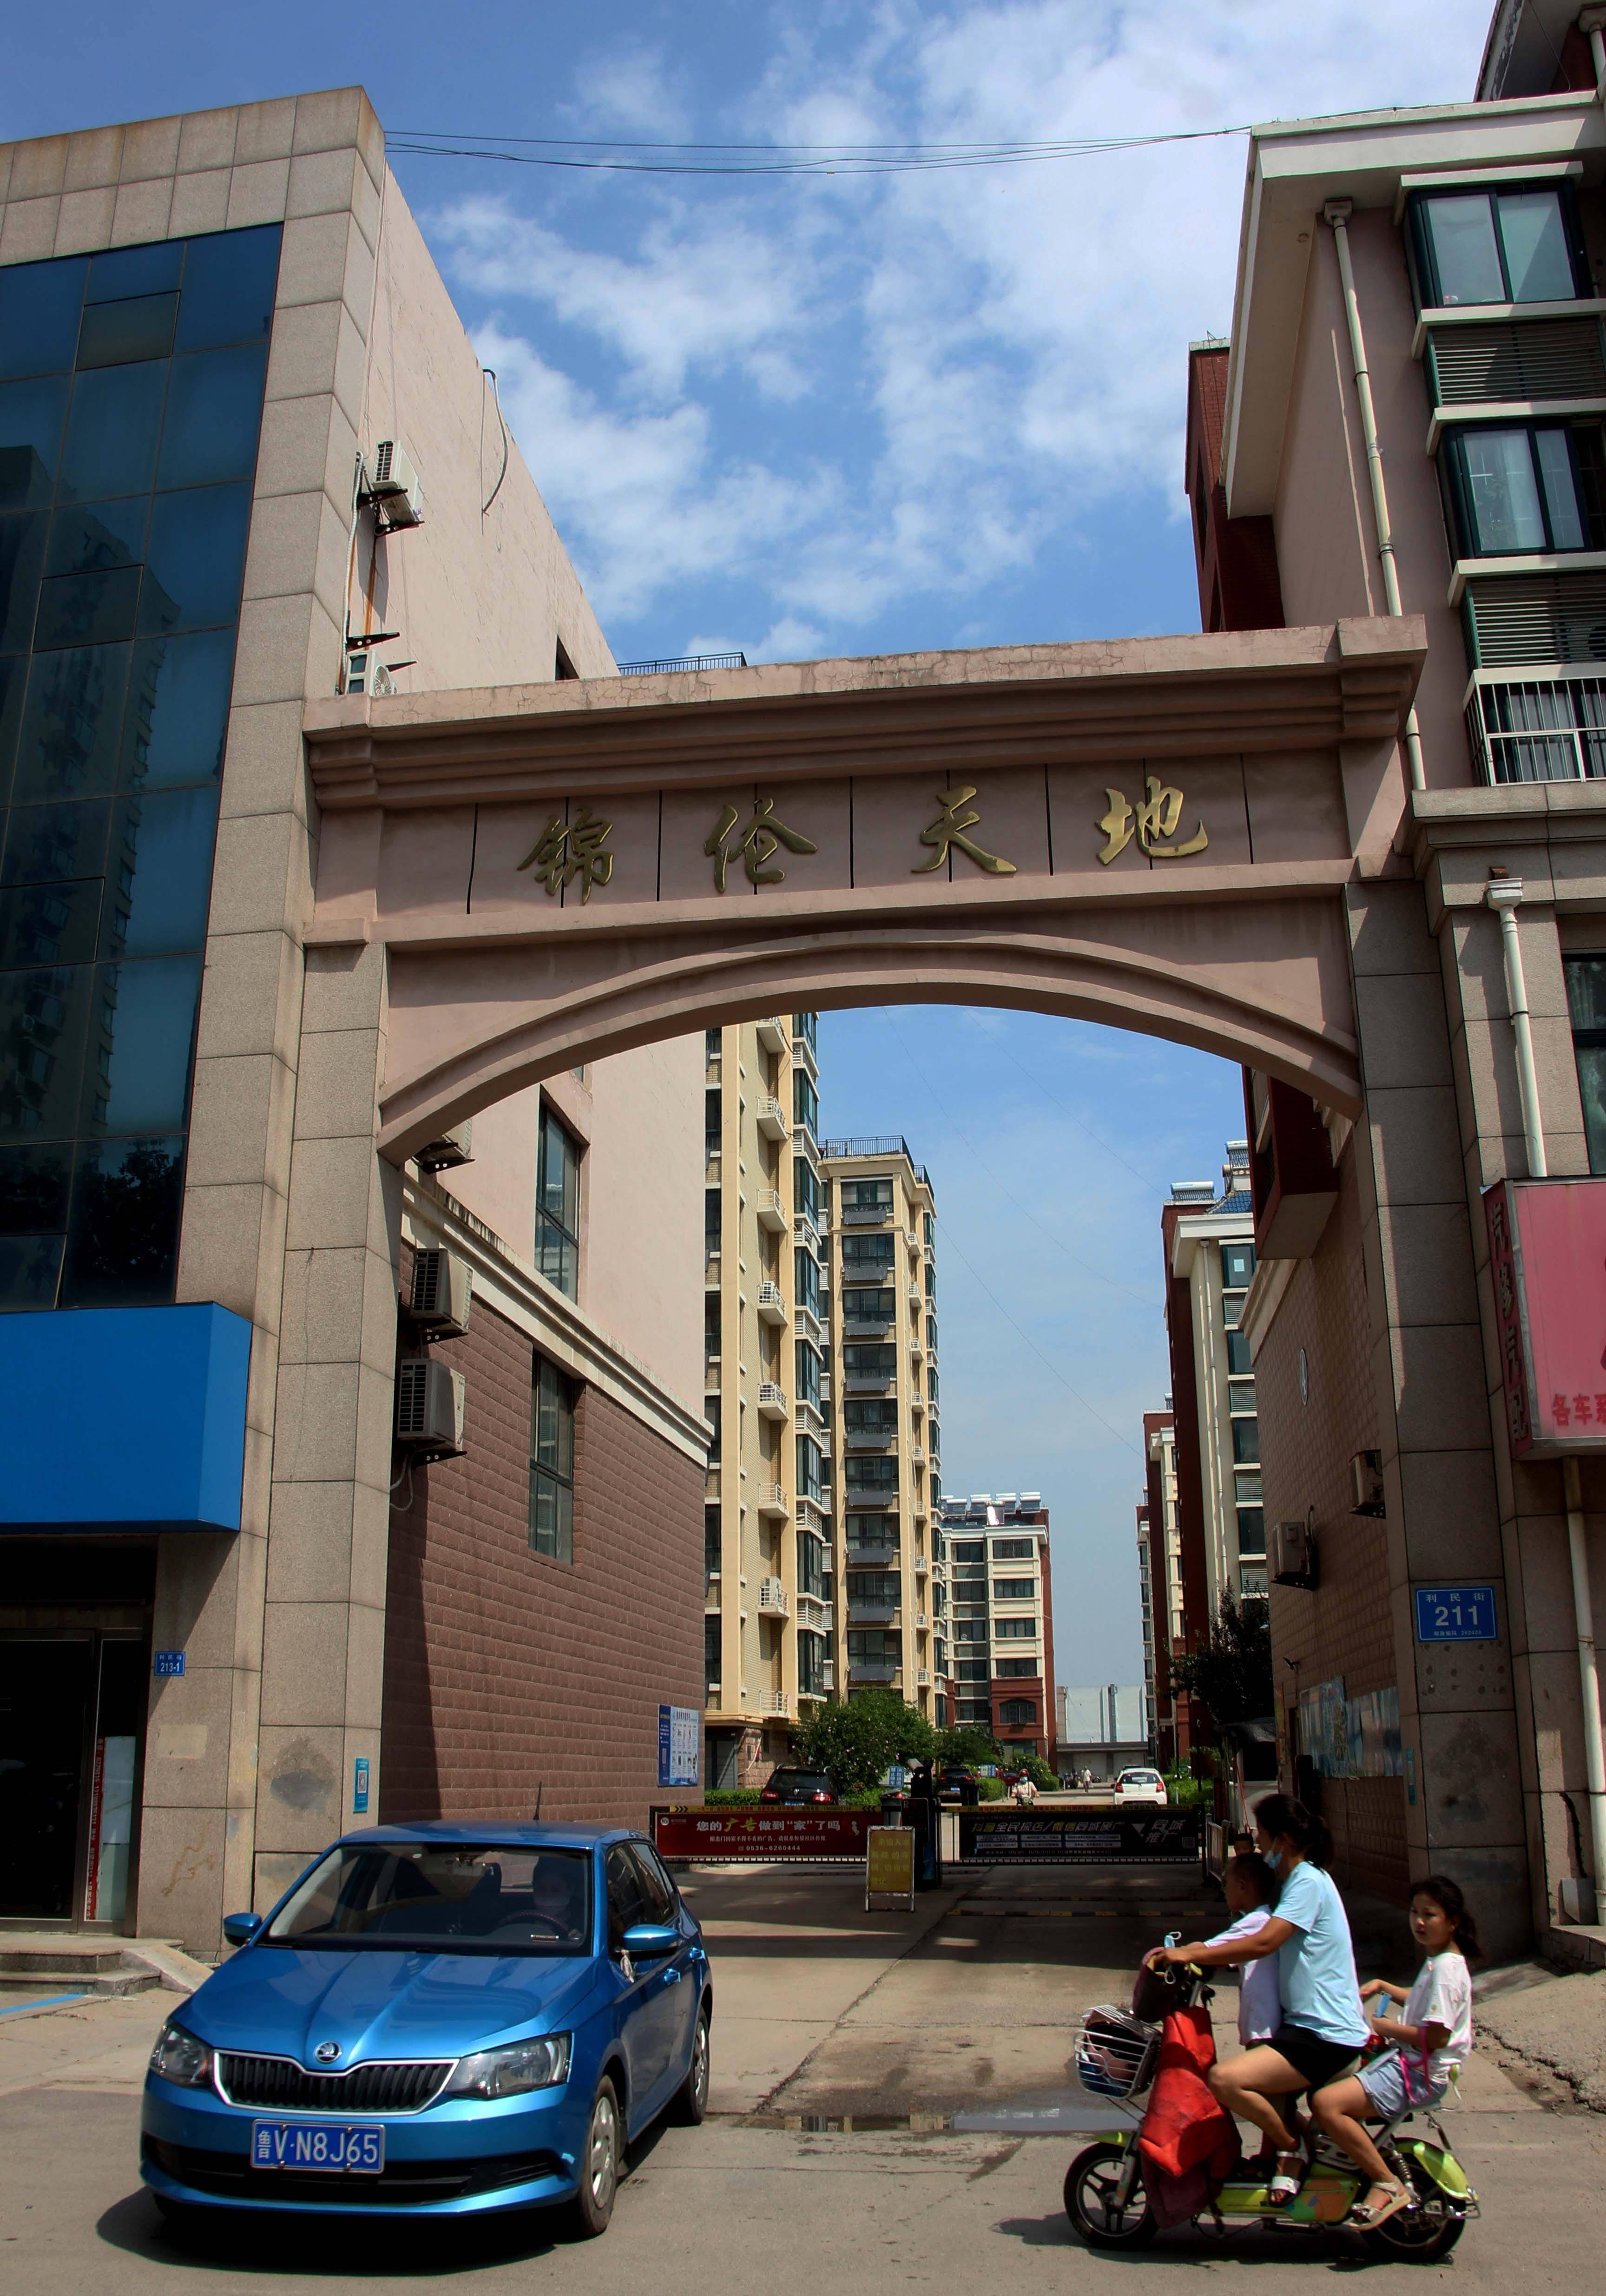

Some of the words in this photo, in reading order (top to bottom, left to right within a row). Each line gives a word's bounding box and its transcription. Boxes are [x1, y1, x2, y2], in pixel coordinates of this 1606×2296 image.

[1426, 1592, 1485, 1603] 利民街
[1435, 1606, 1478, 1627] 211
[160, 1662, 180, 1673] 213-1
[257, 2130, 378, 2164] 鲁V·N8J65
